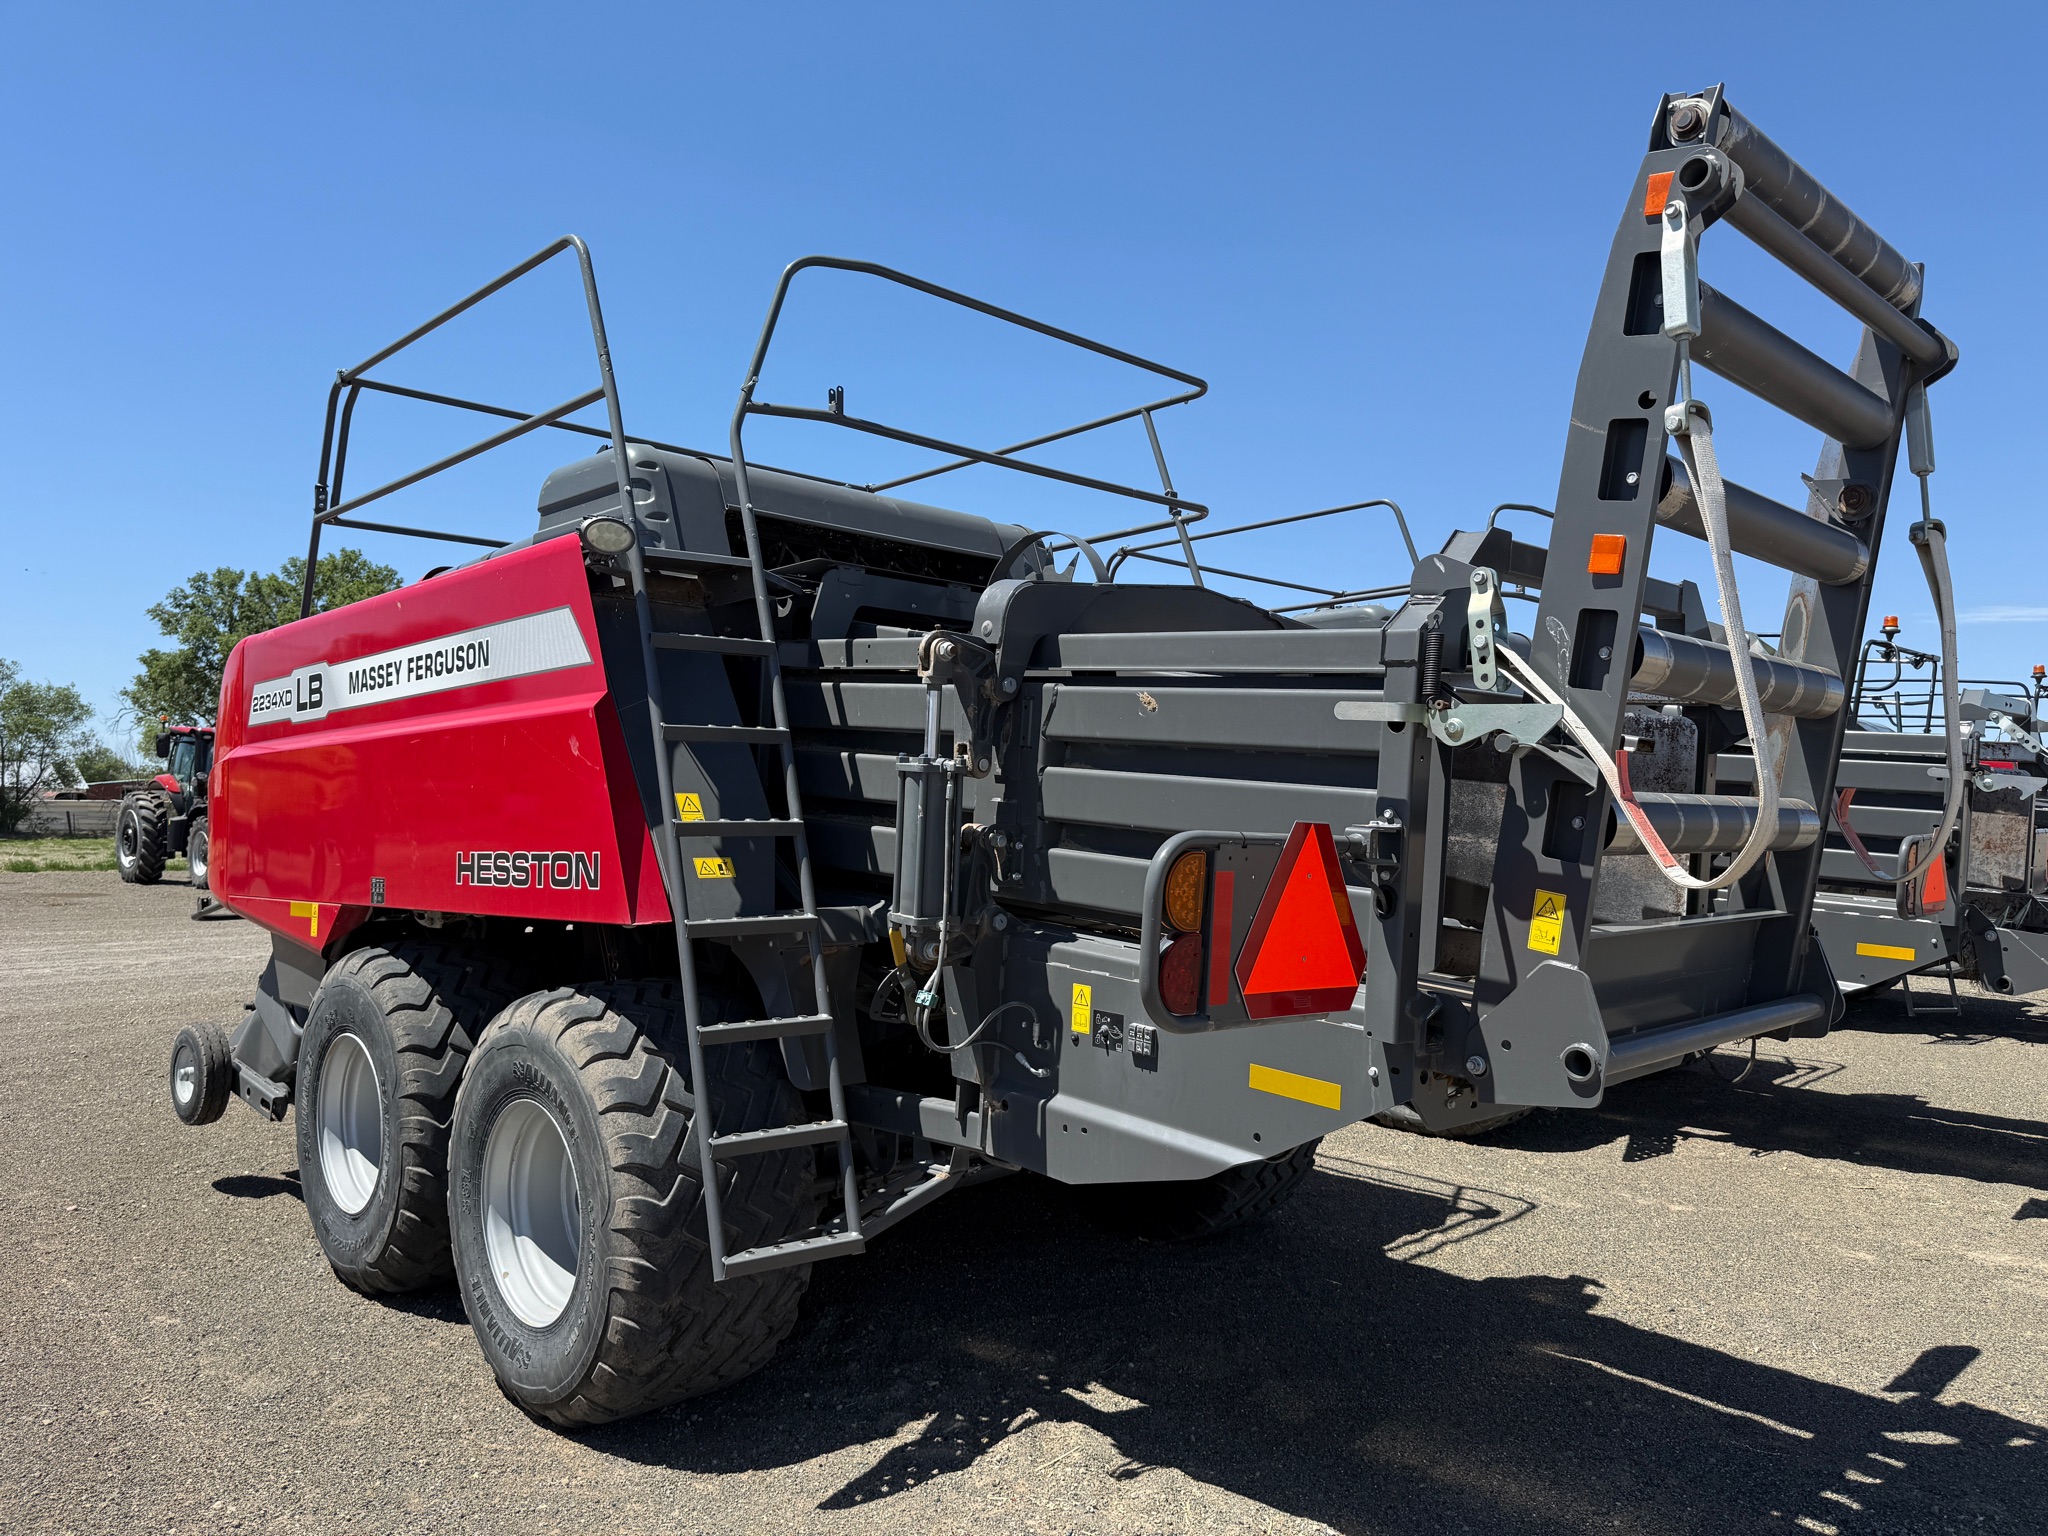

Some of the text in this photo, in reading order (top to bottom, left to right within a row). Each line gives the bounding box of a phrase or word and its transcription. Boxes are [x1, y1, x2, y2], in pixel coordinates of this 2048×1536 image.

[348, 638, 490, 695] MASSEY FERGUSON
[252, 689, 293, 713] 2234XD
[296, 673, 323, 712] LB
[456, 851, 600, 890] HESSTON
[523, 1062, 579, 1146] ALLIANCE
[469, 1273, 525, 1362] ALLIANCE
